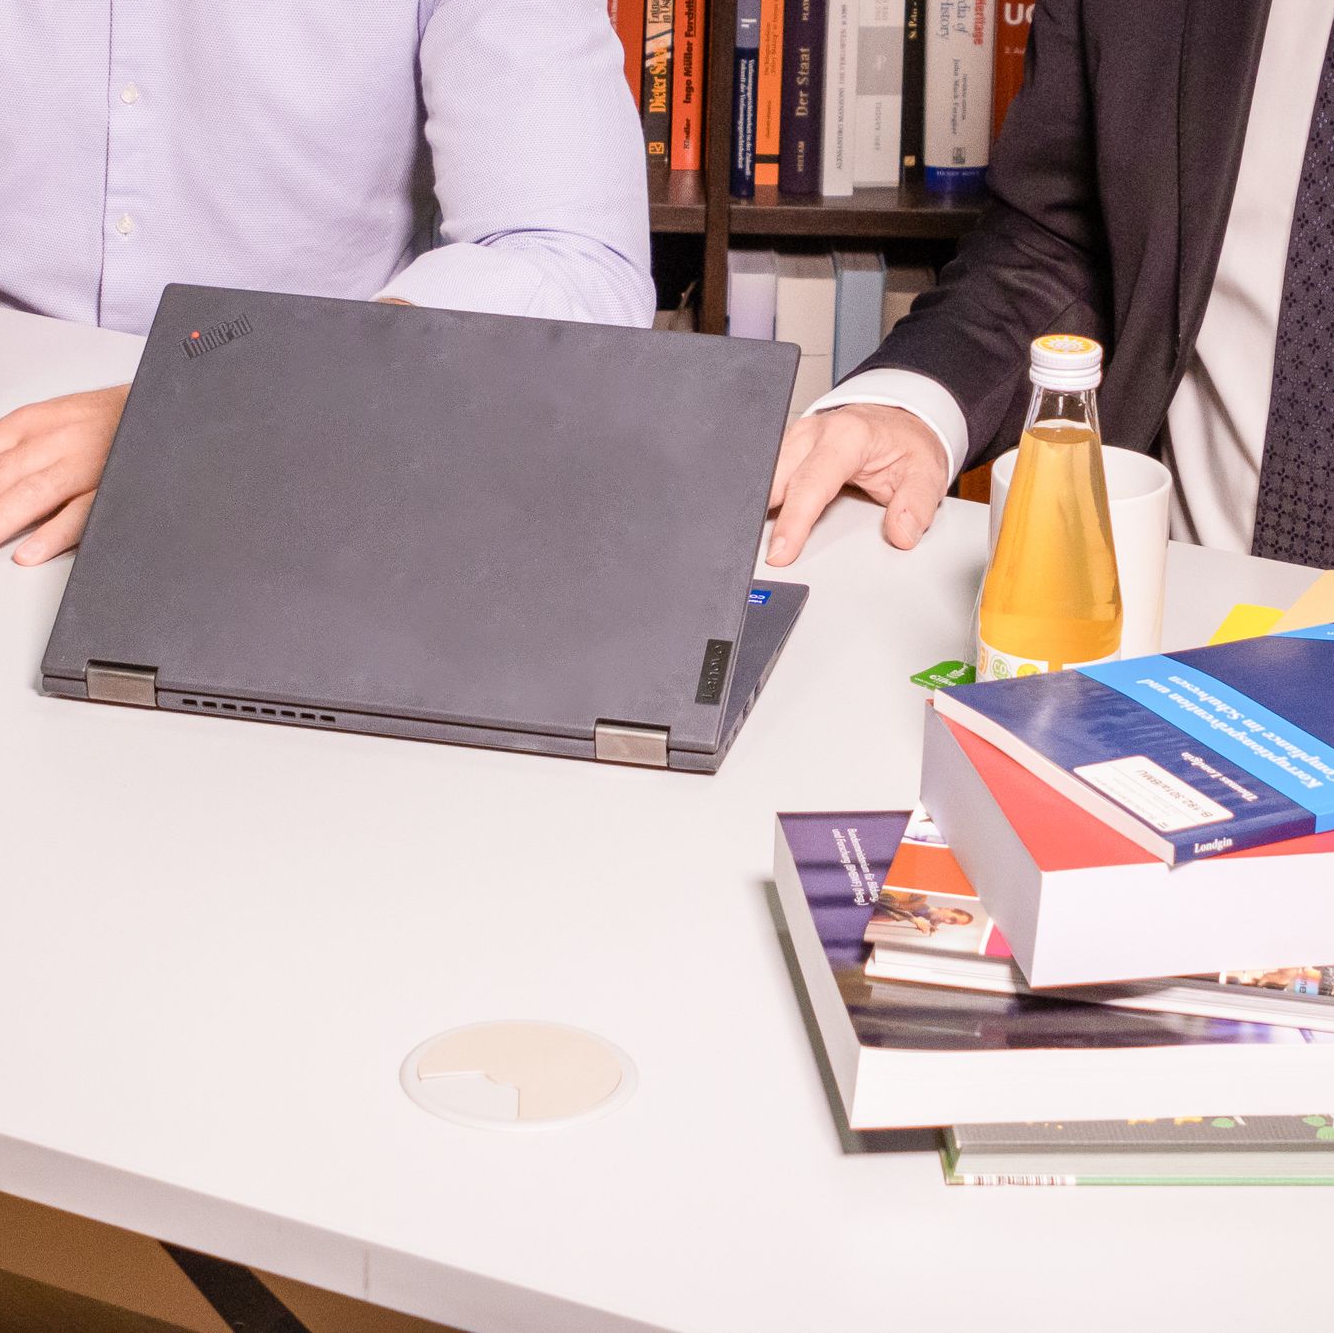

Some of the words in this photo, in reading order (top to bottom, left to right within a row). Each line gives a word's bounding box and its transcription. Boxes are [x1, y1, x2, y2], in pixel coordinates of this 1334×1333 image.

[661, 15, 671, 23] in
[956, 22, 970, 34] of
[682, 41, 693, 77] Müller
[797, 46, 811, 86] Staat
[648, 76, 667, 113] Dieter
[683, 80, 695, 103] Ingo
[795, 91, 809, 116] Der
[683, 118, 691, 149] Kindler
[179, 312, 253, 359] ThinkPad
[701, 644, 722, 697] Lenovo
[1135, 678, 1170, 694] und
[1168, 675, 1245, 721] Schulwesen
[1241, 719, 1266, 733] im
[1168, 693, 1323, 789] Korruptionsprävention
[1181, 752, 1221, 778] Londgin
[1219, 775, 1258, 802] Thomas
[832, 829, 845, 838] und
[1194, 837, 1232, 853] Londgin
[836, 838, 851, 864] Forschung
[848, 828, 869, 873] Bundesministerium
[864, 873, 874, 881] für
